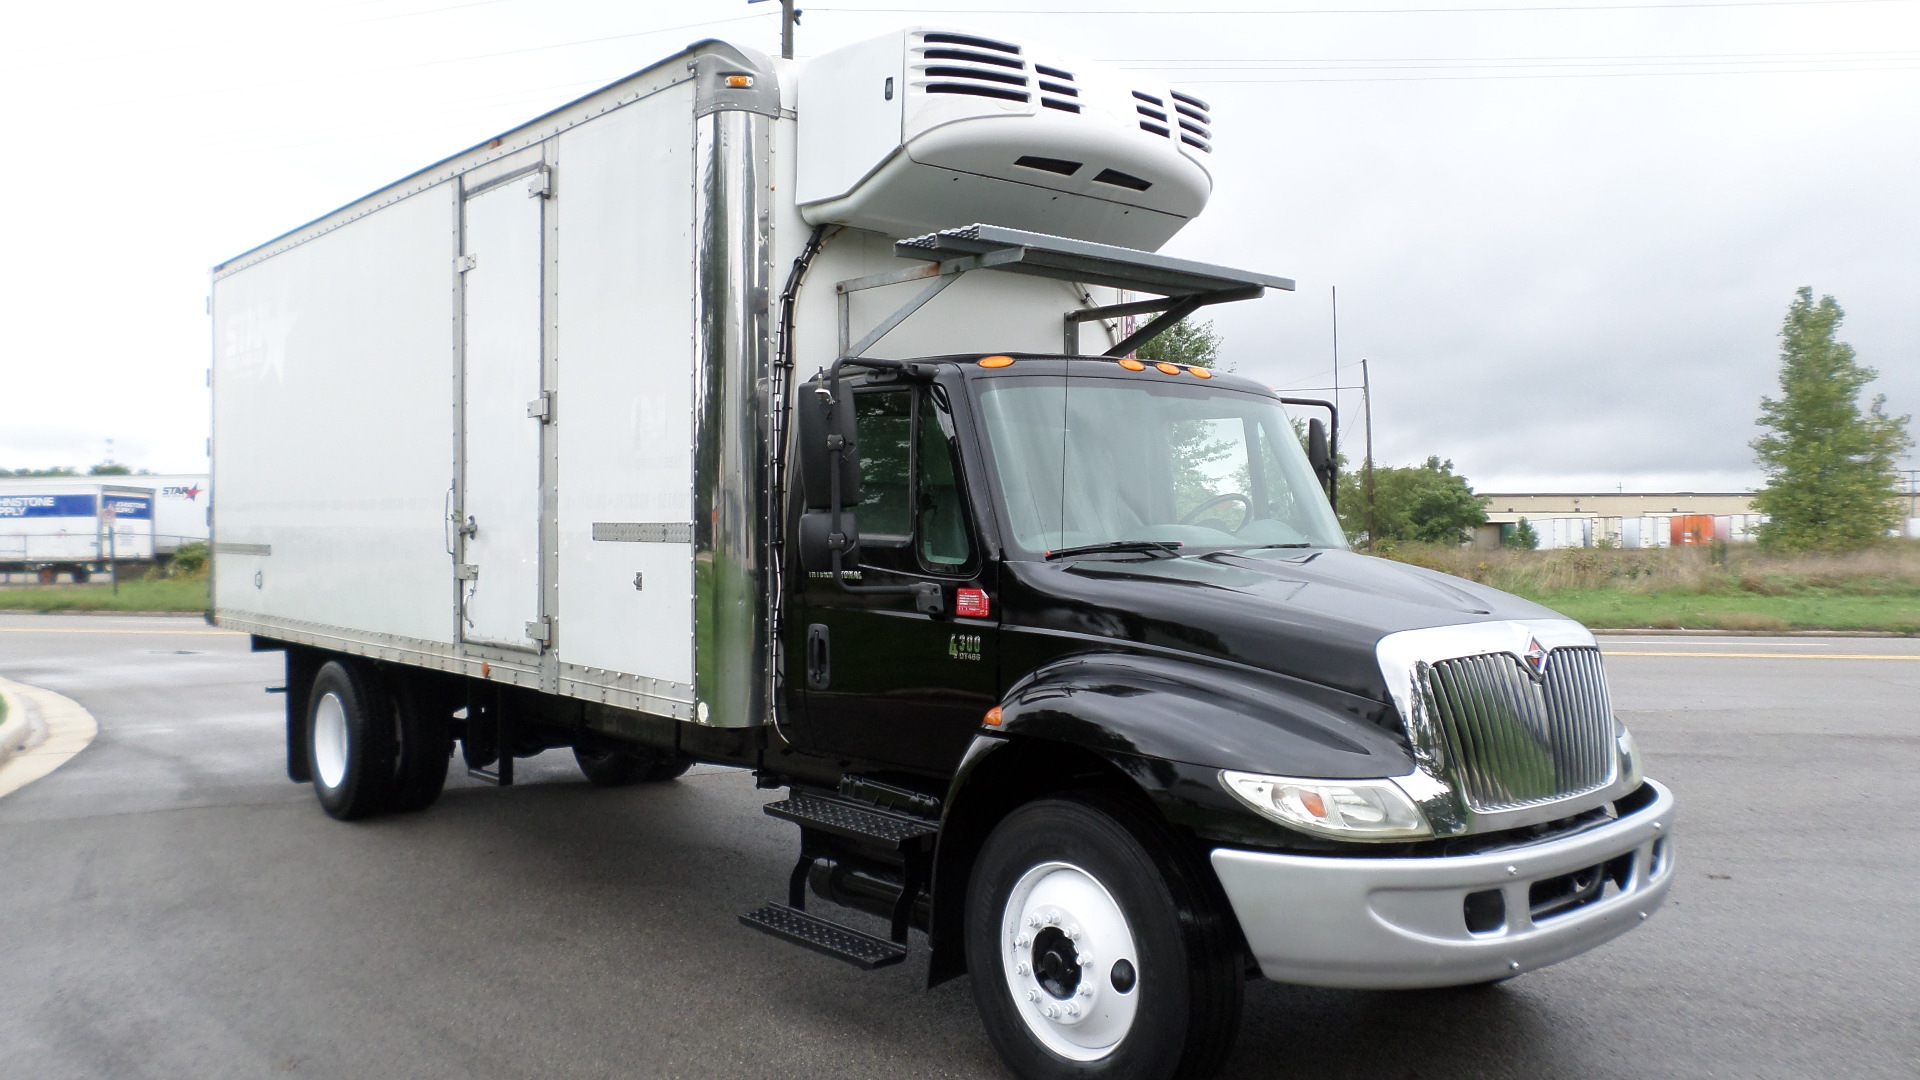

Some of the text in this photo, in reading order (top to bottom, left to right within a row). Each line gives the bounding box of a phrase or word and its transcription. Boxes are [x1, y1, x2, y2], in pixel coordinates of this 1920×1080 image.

[162, 486, 189, 496] STAR
[808, 570, 862, 579] INTERNIONAL
[948, 633, 981, 657] 4300
